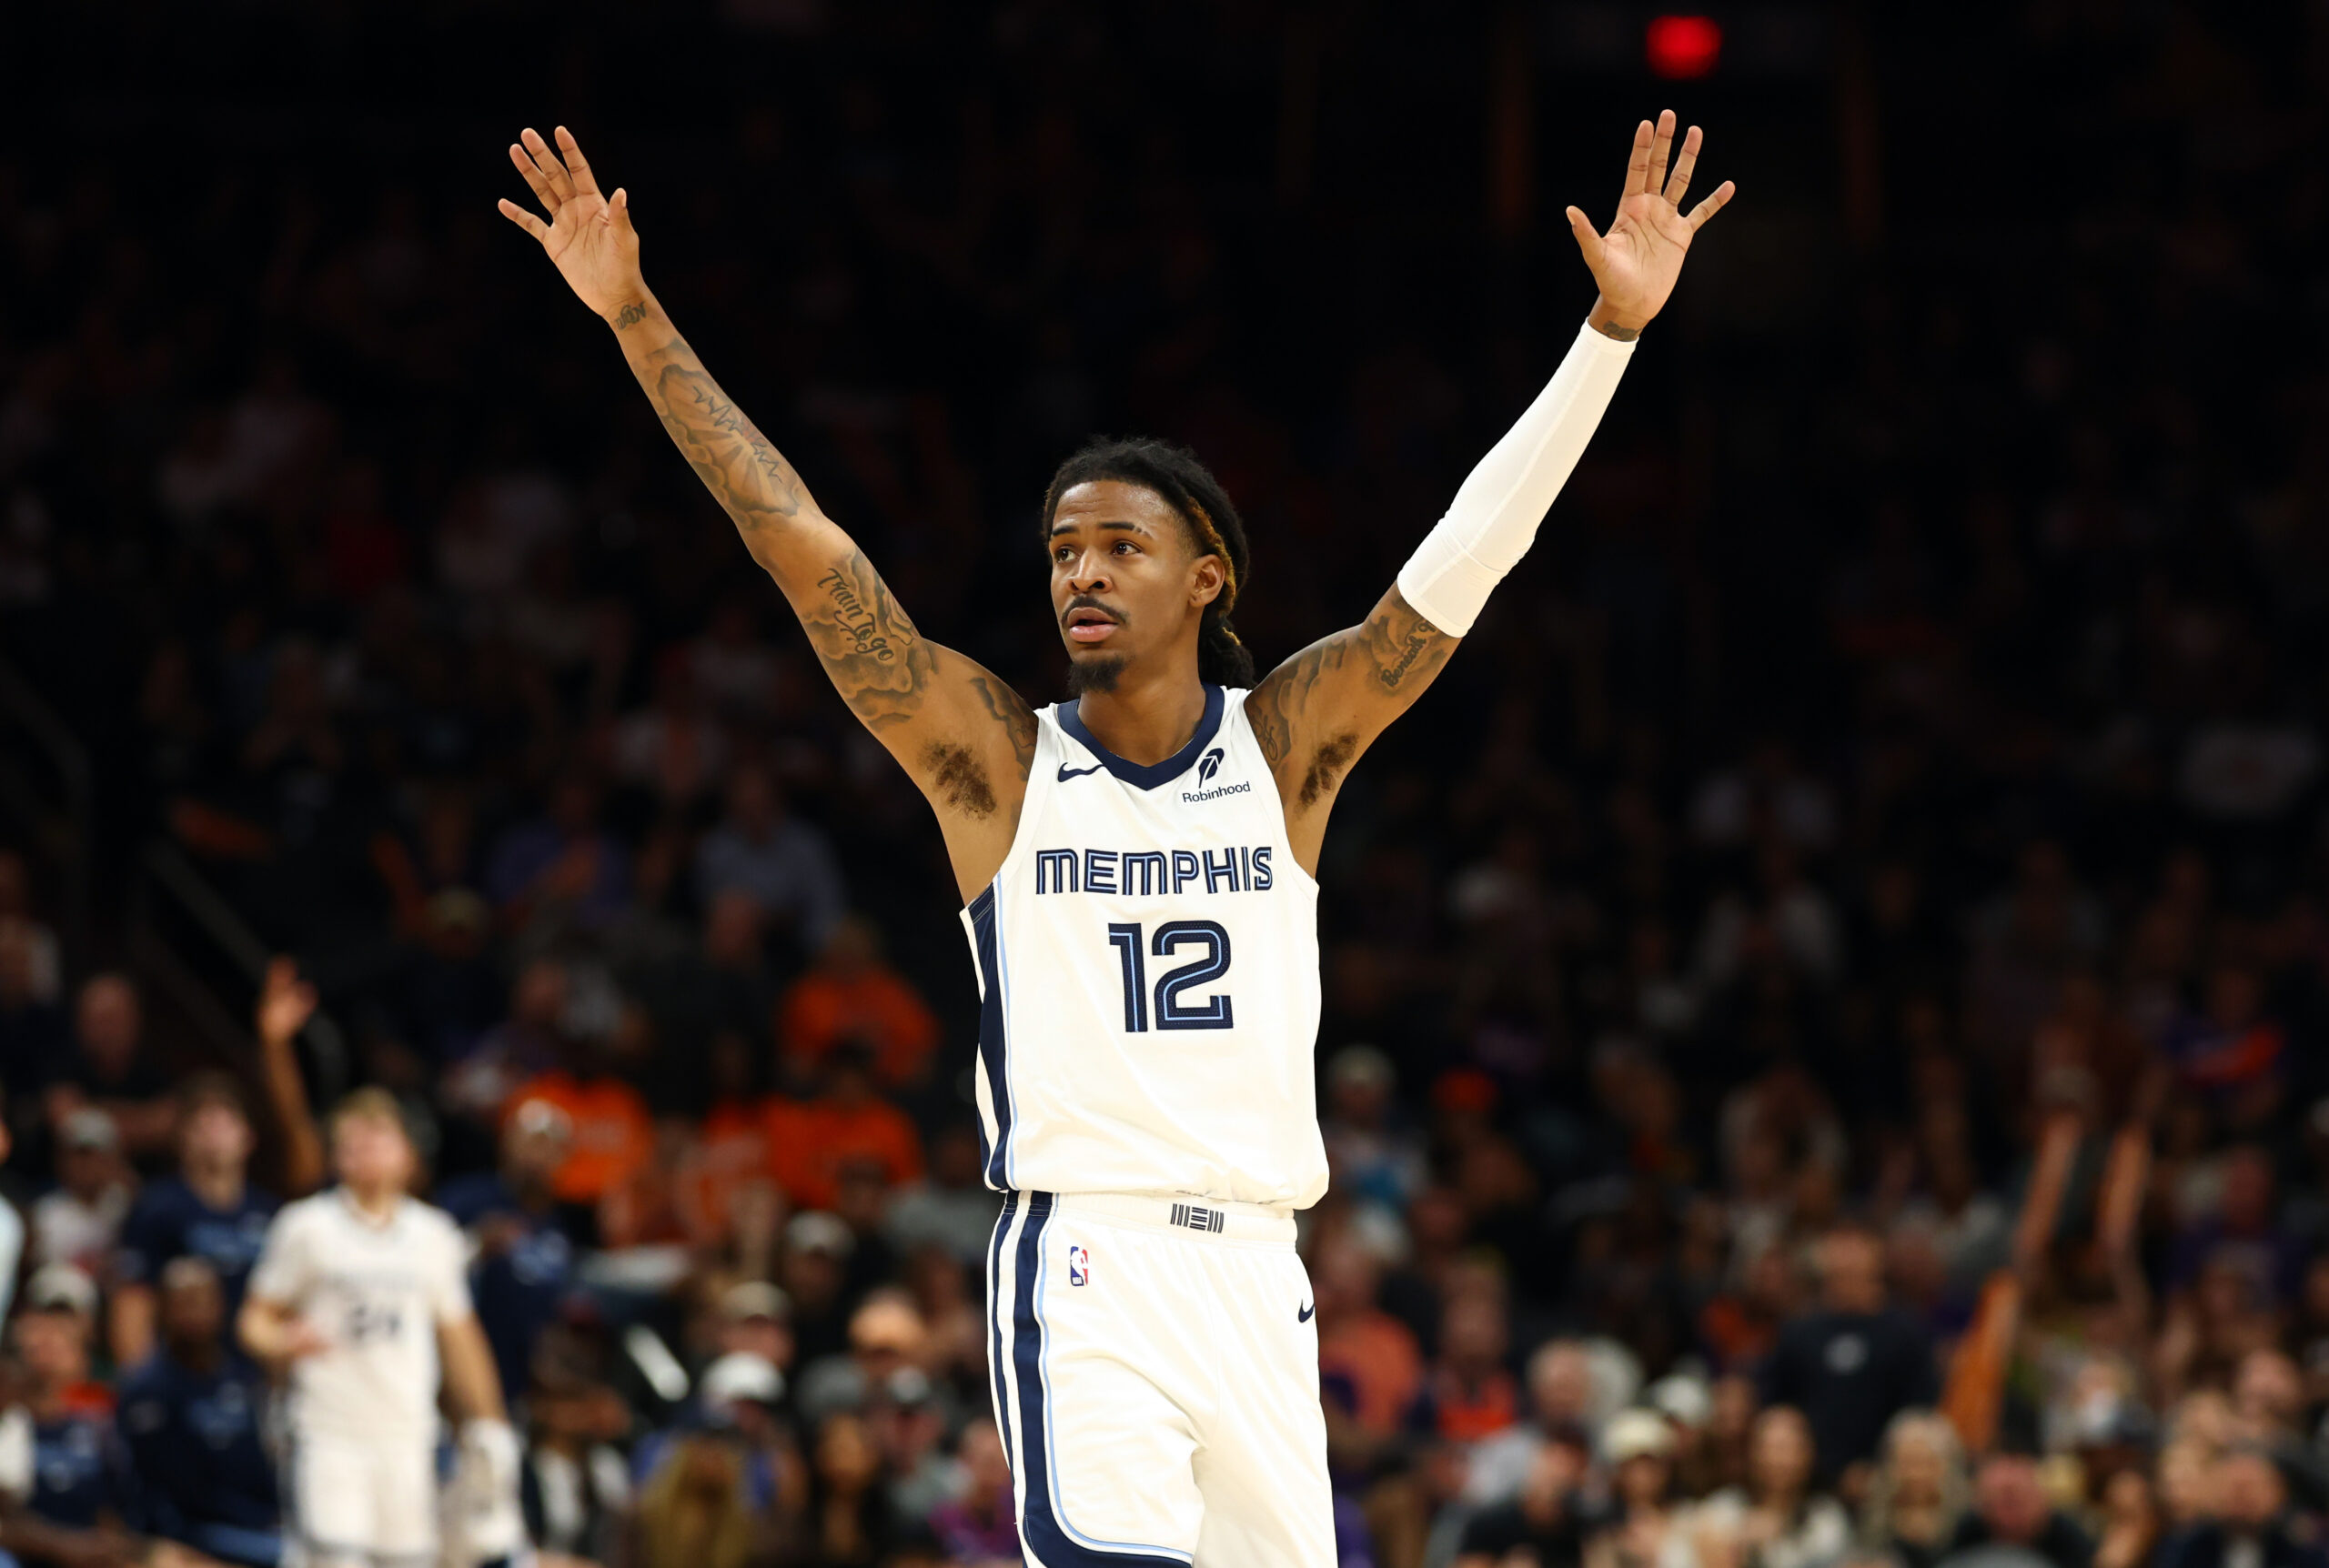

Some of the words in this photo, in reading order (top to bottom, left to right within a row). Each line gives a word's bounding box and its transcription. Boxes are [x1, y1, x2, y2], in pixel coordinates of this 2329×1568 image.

[1183, 781, 1251, 803] Robinhood
[1035, 847, 1273, 895] MEMPHIS
[1108, 920, 1234, 1032] 12
